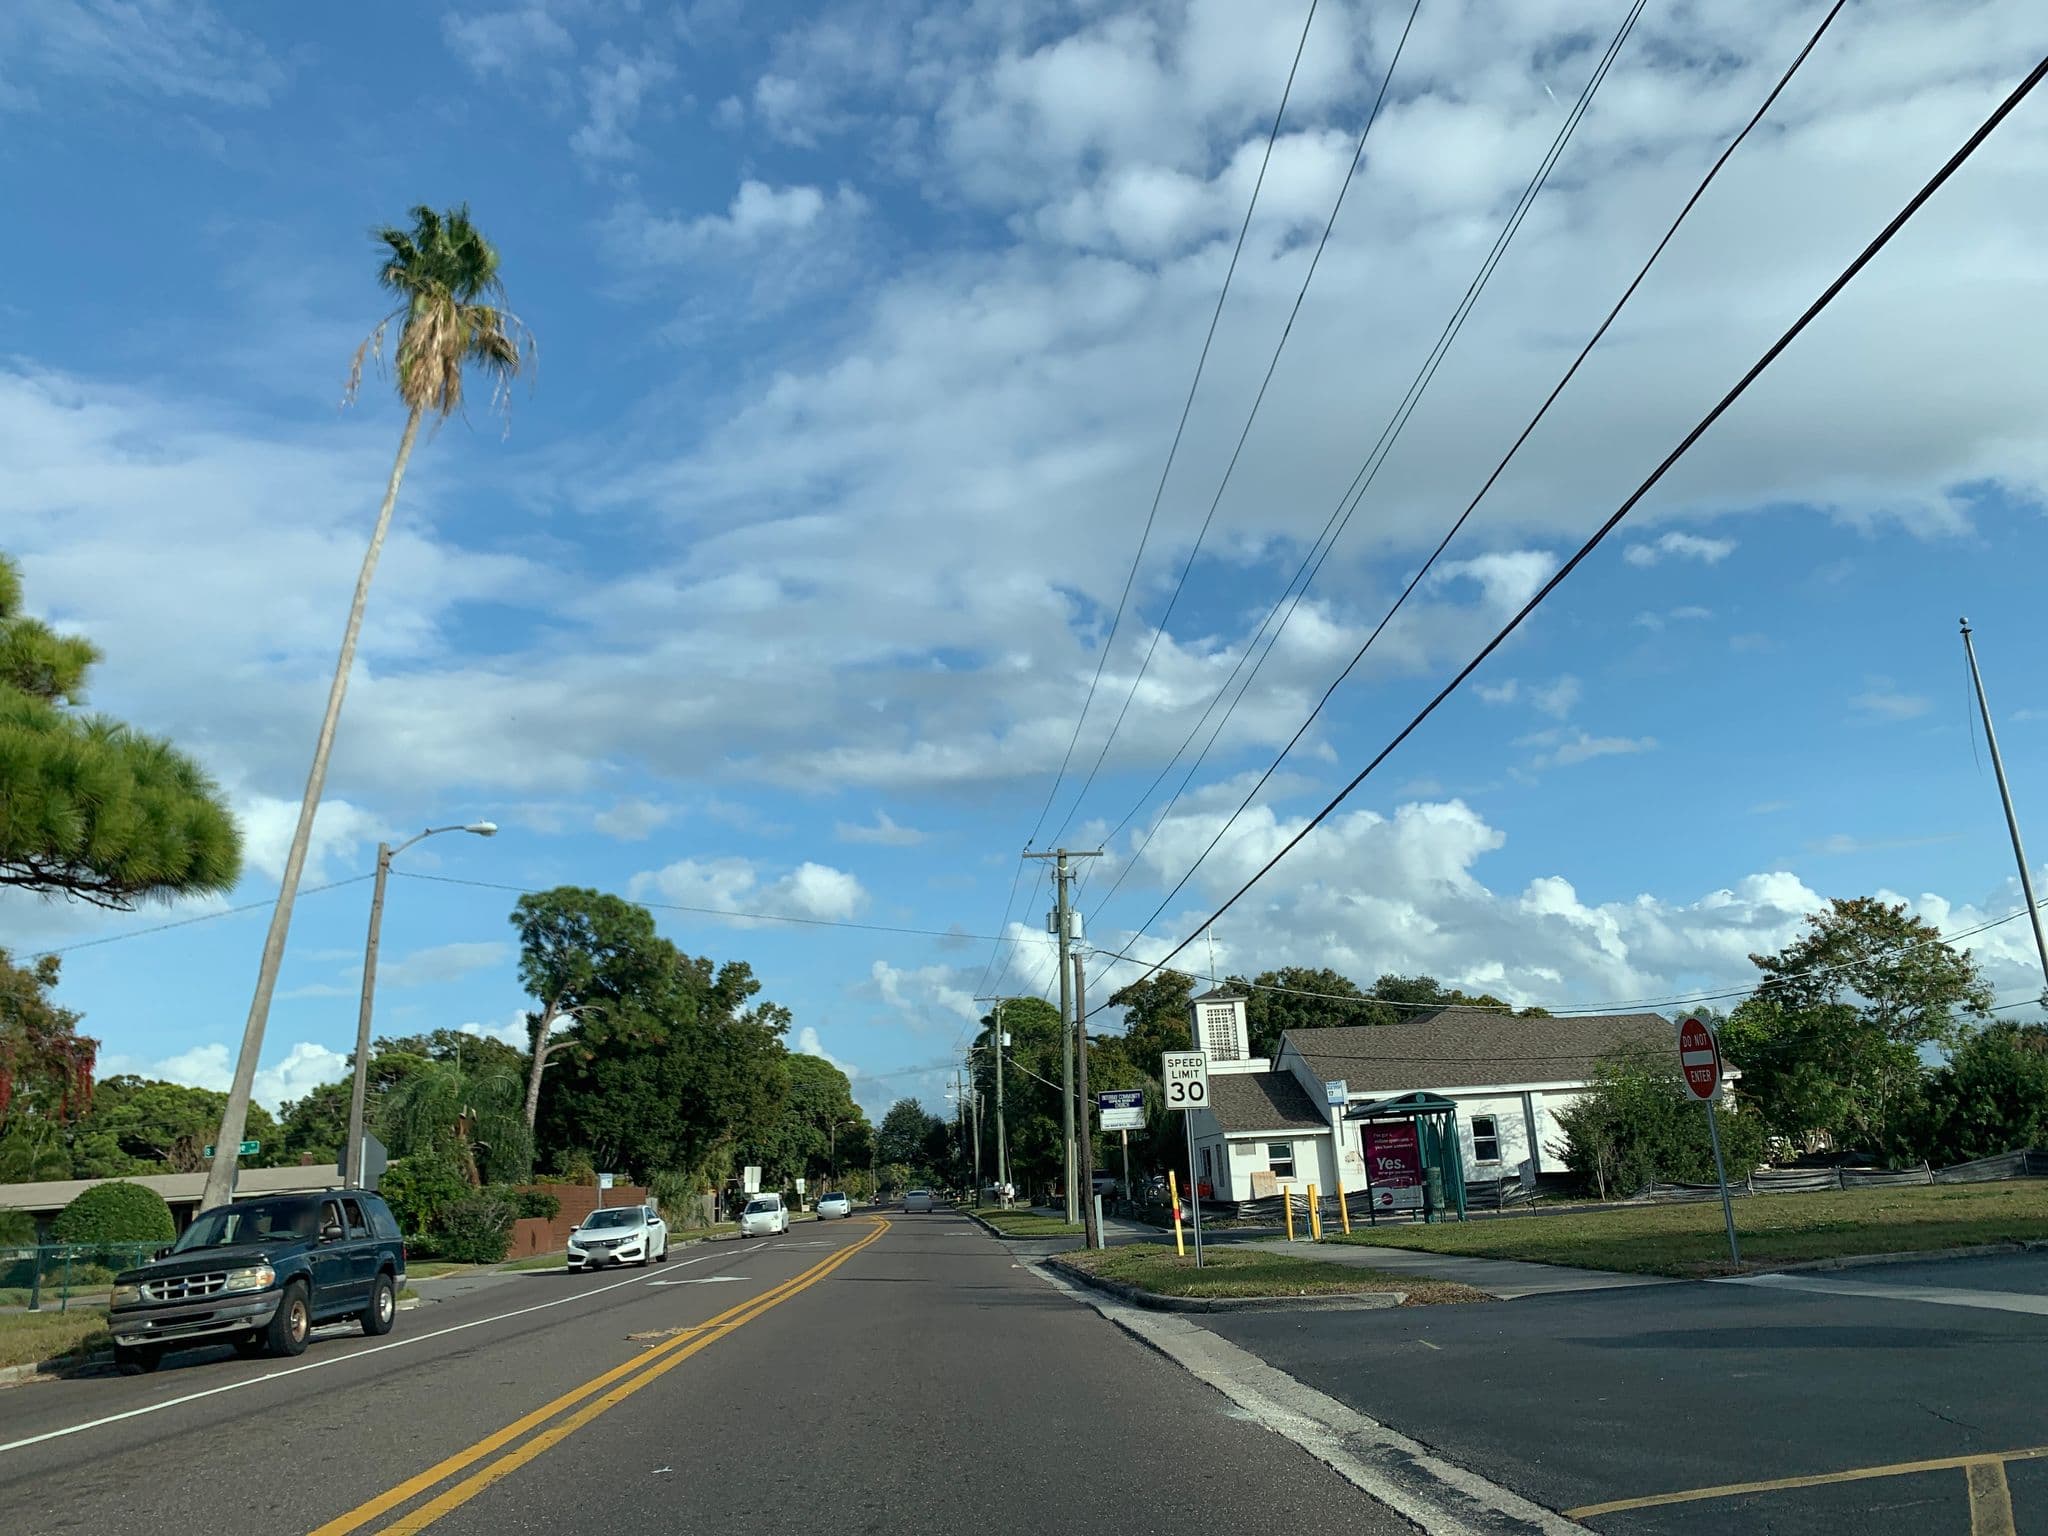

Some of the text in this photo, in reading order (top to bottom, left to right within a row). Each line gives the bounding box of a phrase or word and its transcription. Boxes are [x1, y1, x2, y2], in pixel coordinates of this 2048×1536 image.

[1682, 1033, 1707, 1047] DO NOT
[1167, 1058, 1203, 1067] SPEED
[1171, 1069, 1200, 1079] LIMIT
[1690, 1069, 1712, 1082] ENTER
[1170, 1081, 1204, 1102] 30
[1376, 1157, 1406, 1170] Yes.
